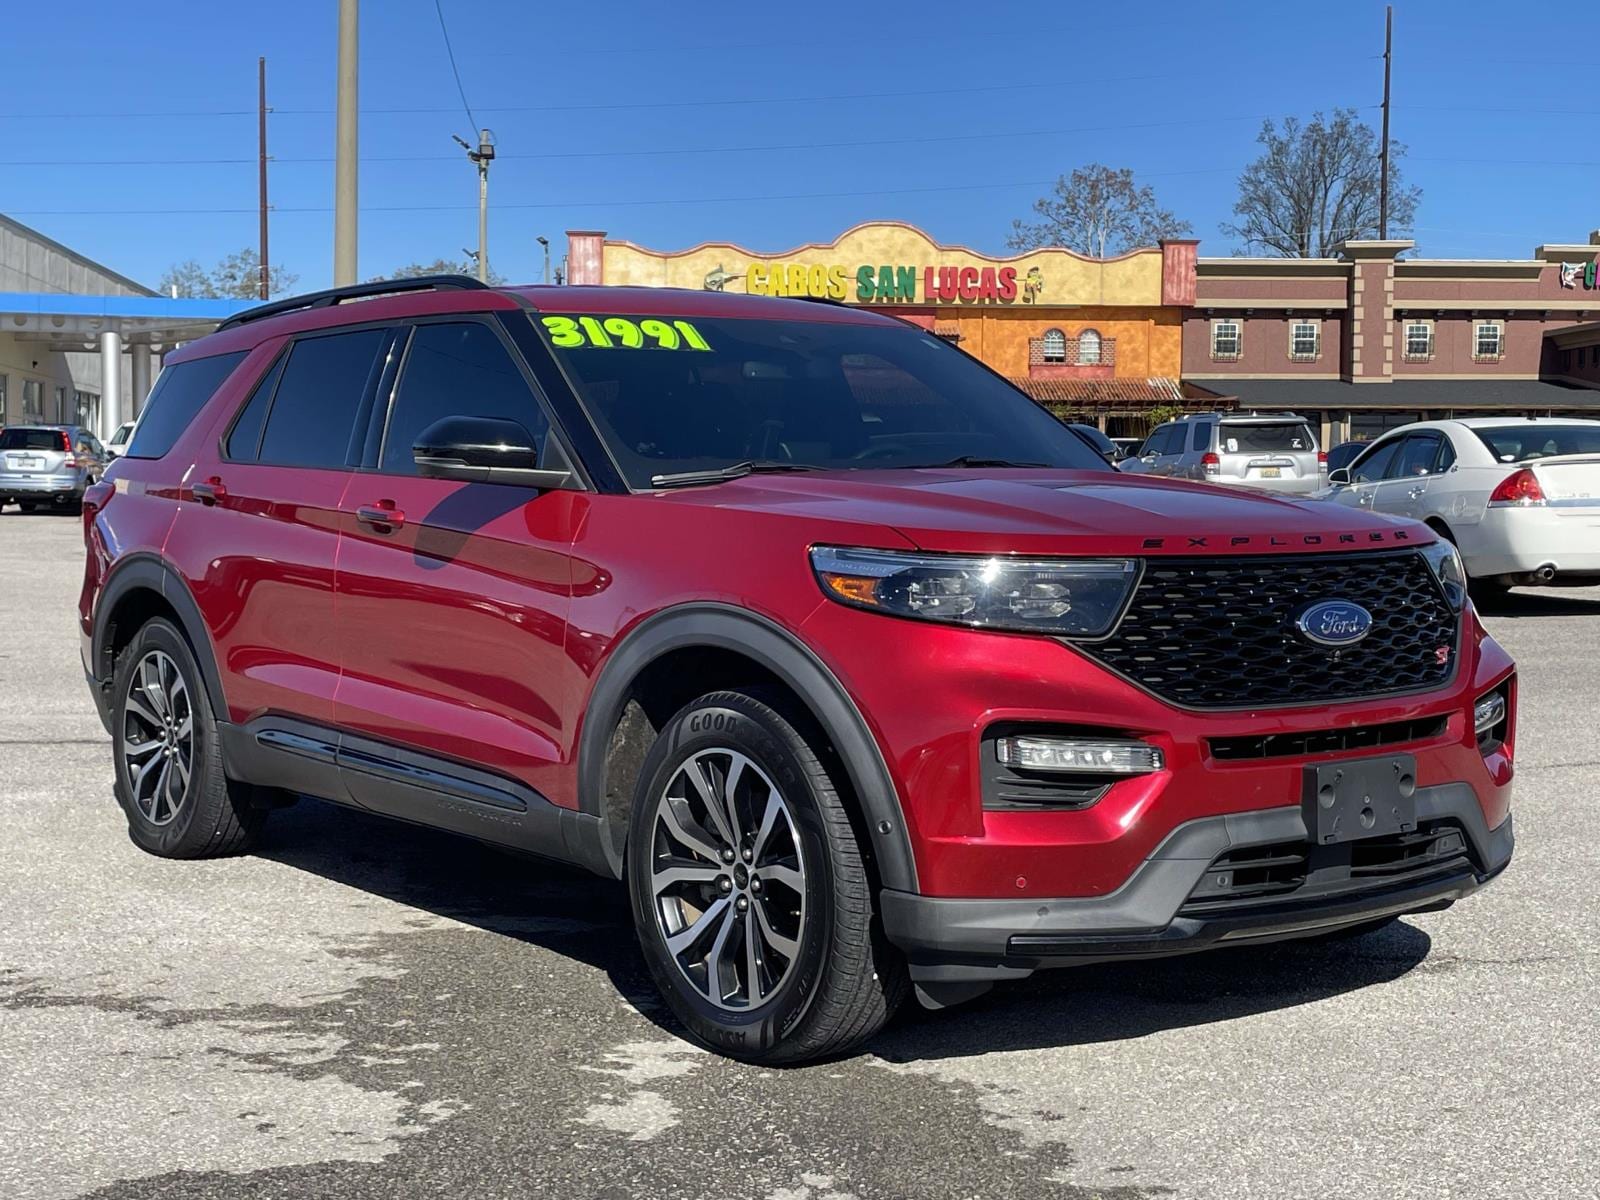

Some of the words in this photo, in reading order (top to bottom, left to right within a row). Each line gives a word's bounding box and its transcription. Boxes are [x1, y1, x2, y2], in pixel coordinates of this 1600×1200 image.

[746, 263, 847, 298] CABOS
[857, 265, 916, 298] SAN
[924, 266, 1018, 299] LUCAS
[541, 316, 711, 350] 31991
[1142, 530, 1409, 549] EXPLORER
[1320, 610, 1359, 635] Ford
